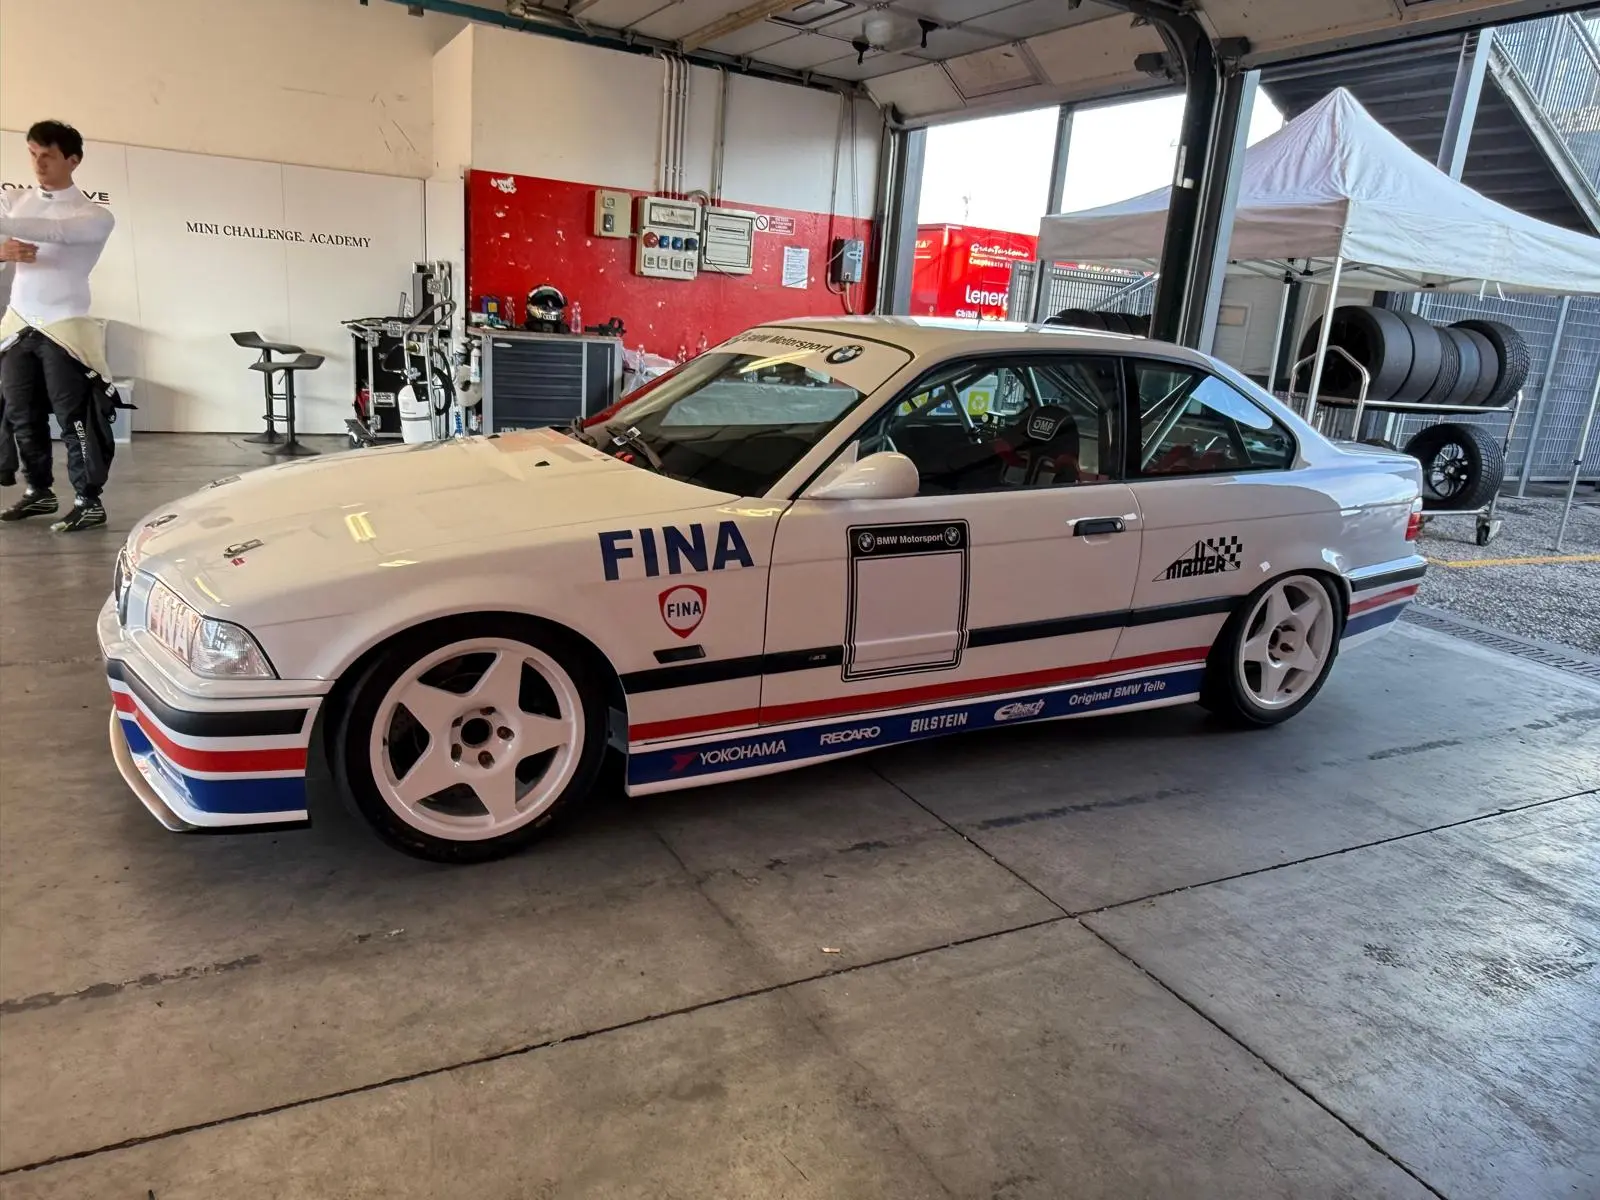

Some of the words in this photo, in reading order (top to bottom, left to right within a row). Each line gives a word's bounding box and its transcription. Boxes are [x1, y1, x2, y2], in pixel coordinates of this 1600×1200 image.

[186, 221, 219, 235] MINI
[309, 233, 371, 248] ACADEMY
[767, 335, 832, 353] Motorsport
[1033, 419, 1054, 432] OMP
[876, 535, 898, 546] BMW
[899, 533, 943, 545] Motorsport
[598, 520, 755, 581] FINA
[667, 600, 702, 618] FINA
[1069, 690, 1112, 706] Original
[1113, 683, 1141, 698] BMW
[910, 712, 968, 733] BILSTEIN
[820, 726, 880, 746] RECARO
[700, 740, 787, 765] YOKOHAMA
